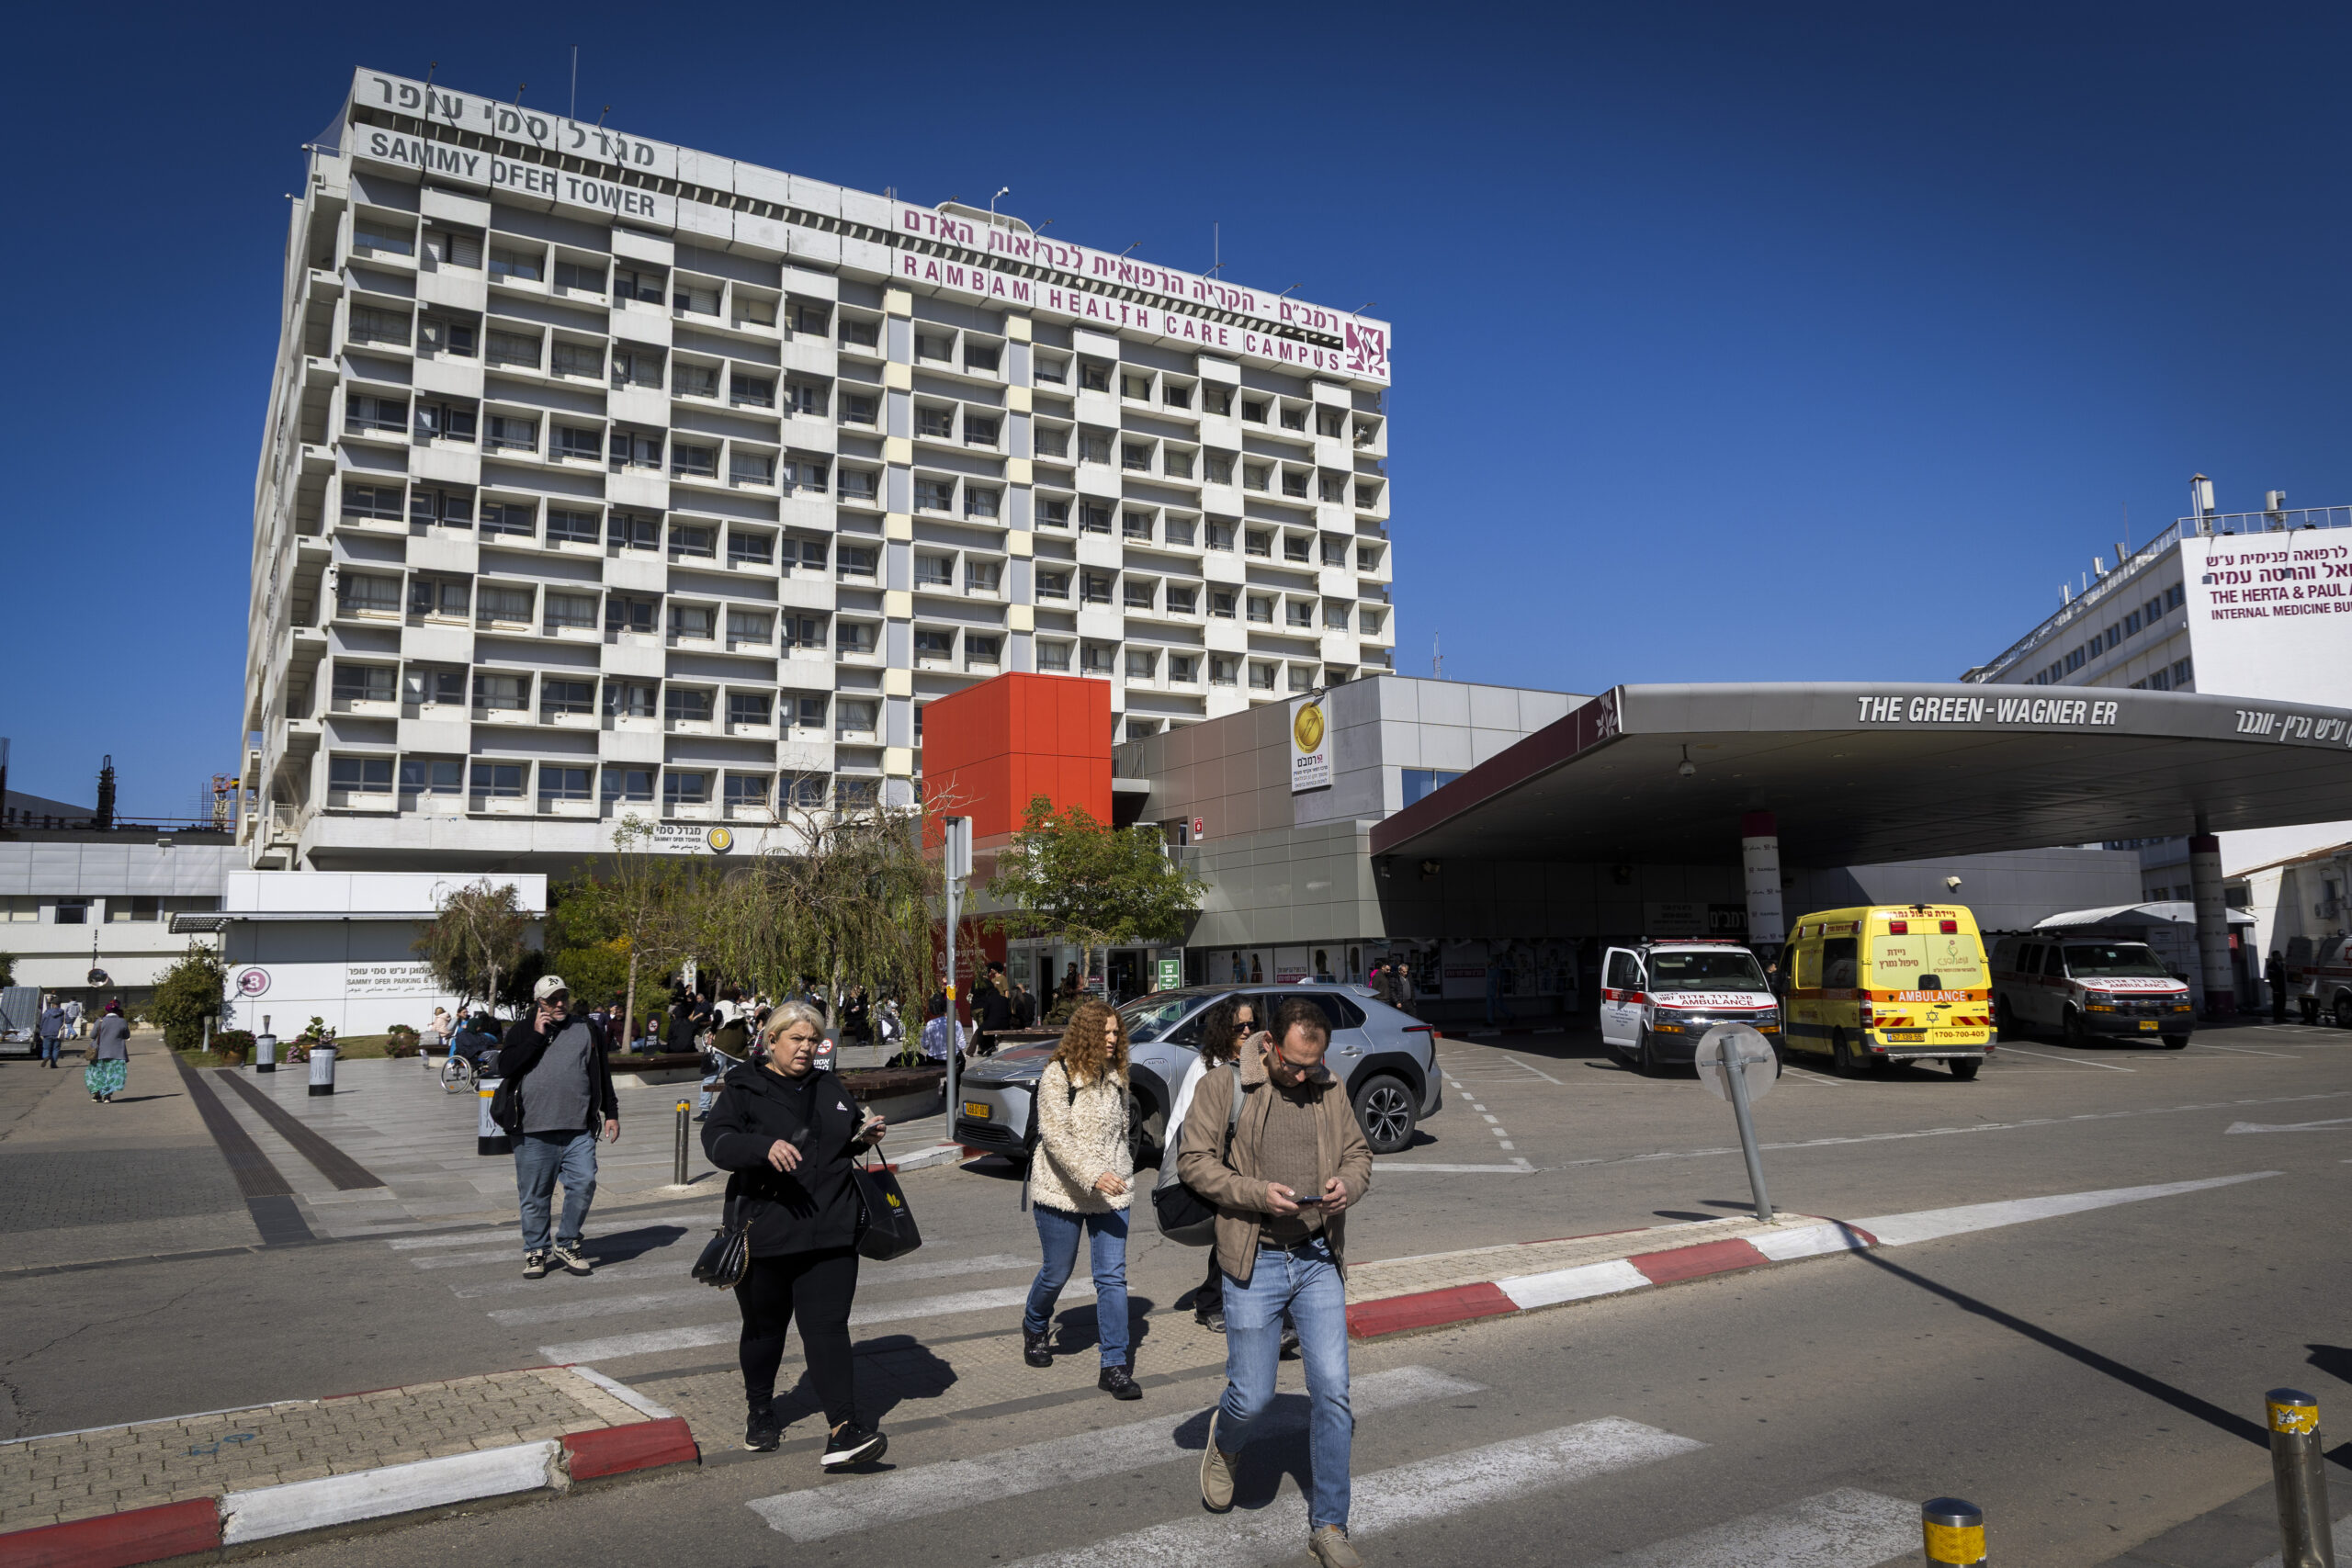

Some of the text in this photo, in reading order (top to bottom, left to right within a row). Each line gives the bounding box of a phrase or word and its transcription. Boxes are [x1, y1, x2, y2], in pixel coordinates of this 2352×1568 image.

[373, 77, 655, 166] מגדל סמי עופר
[370, 132, 655, 218] SAMMY OFER TOWER
[904, 209, 974, 244] האדם
[988, 229, 1084, 268] לבריאות
[1092, 255, 1183, 294] הרפואית
[1193, 280, 1254, 311] הקריה
[904, 254, 1340, 370] RAMBAM HEALTH CARE CAMPUS
[2240, 552, 2289, 565] פנימית
[2293, 546, 2347, 561] לרפואה
[2210, 583, 2346, 604] THE HERTA & PAUL
[2211, 607, 2269, 620] INTERNAL
[2273, 603, 2331, 616] MEDICINE
[1858, 696, 2118, 725] THE GREEN-WAGNER ER
[656, 827, 673, 835] סמי
[677, 827, 701, 835] מגדל
[716, 833, 723, 844] 1
[1887, 948, 1905, 956] ניידת
[1879, 958, 1918, 969] טיפול נמרץ
[248, 976, 260, 988] 3
[1898, 990, 1966, 1002] AMBULANCE
